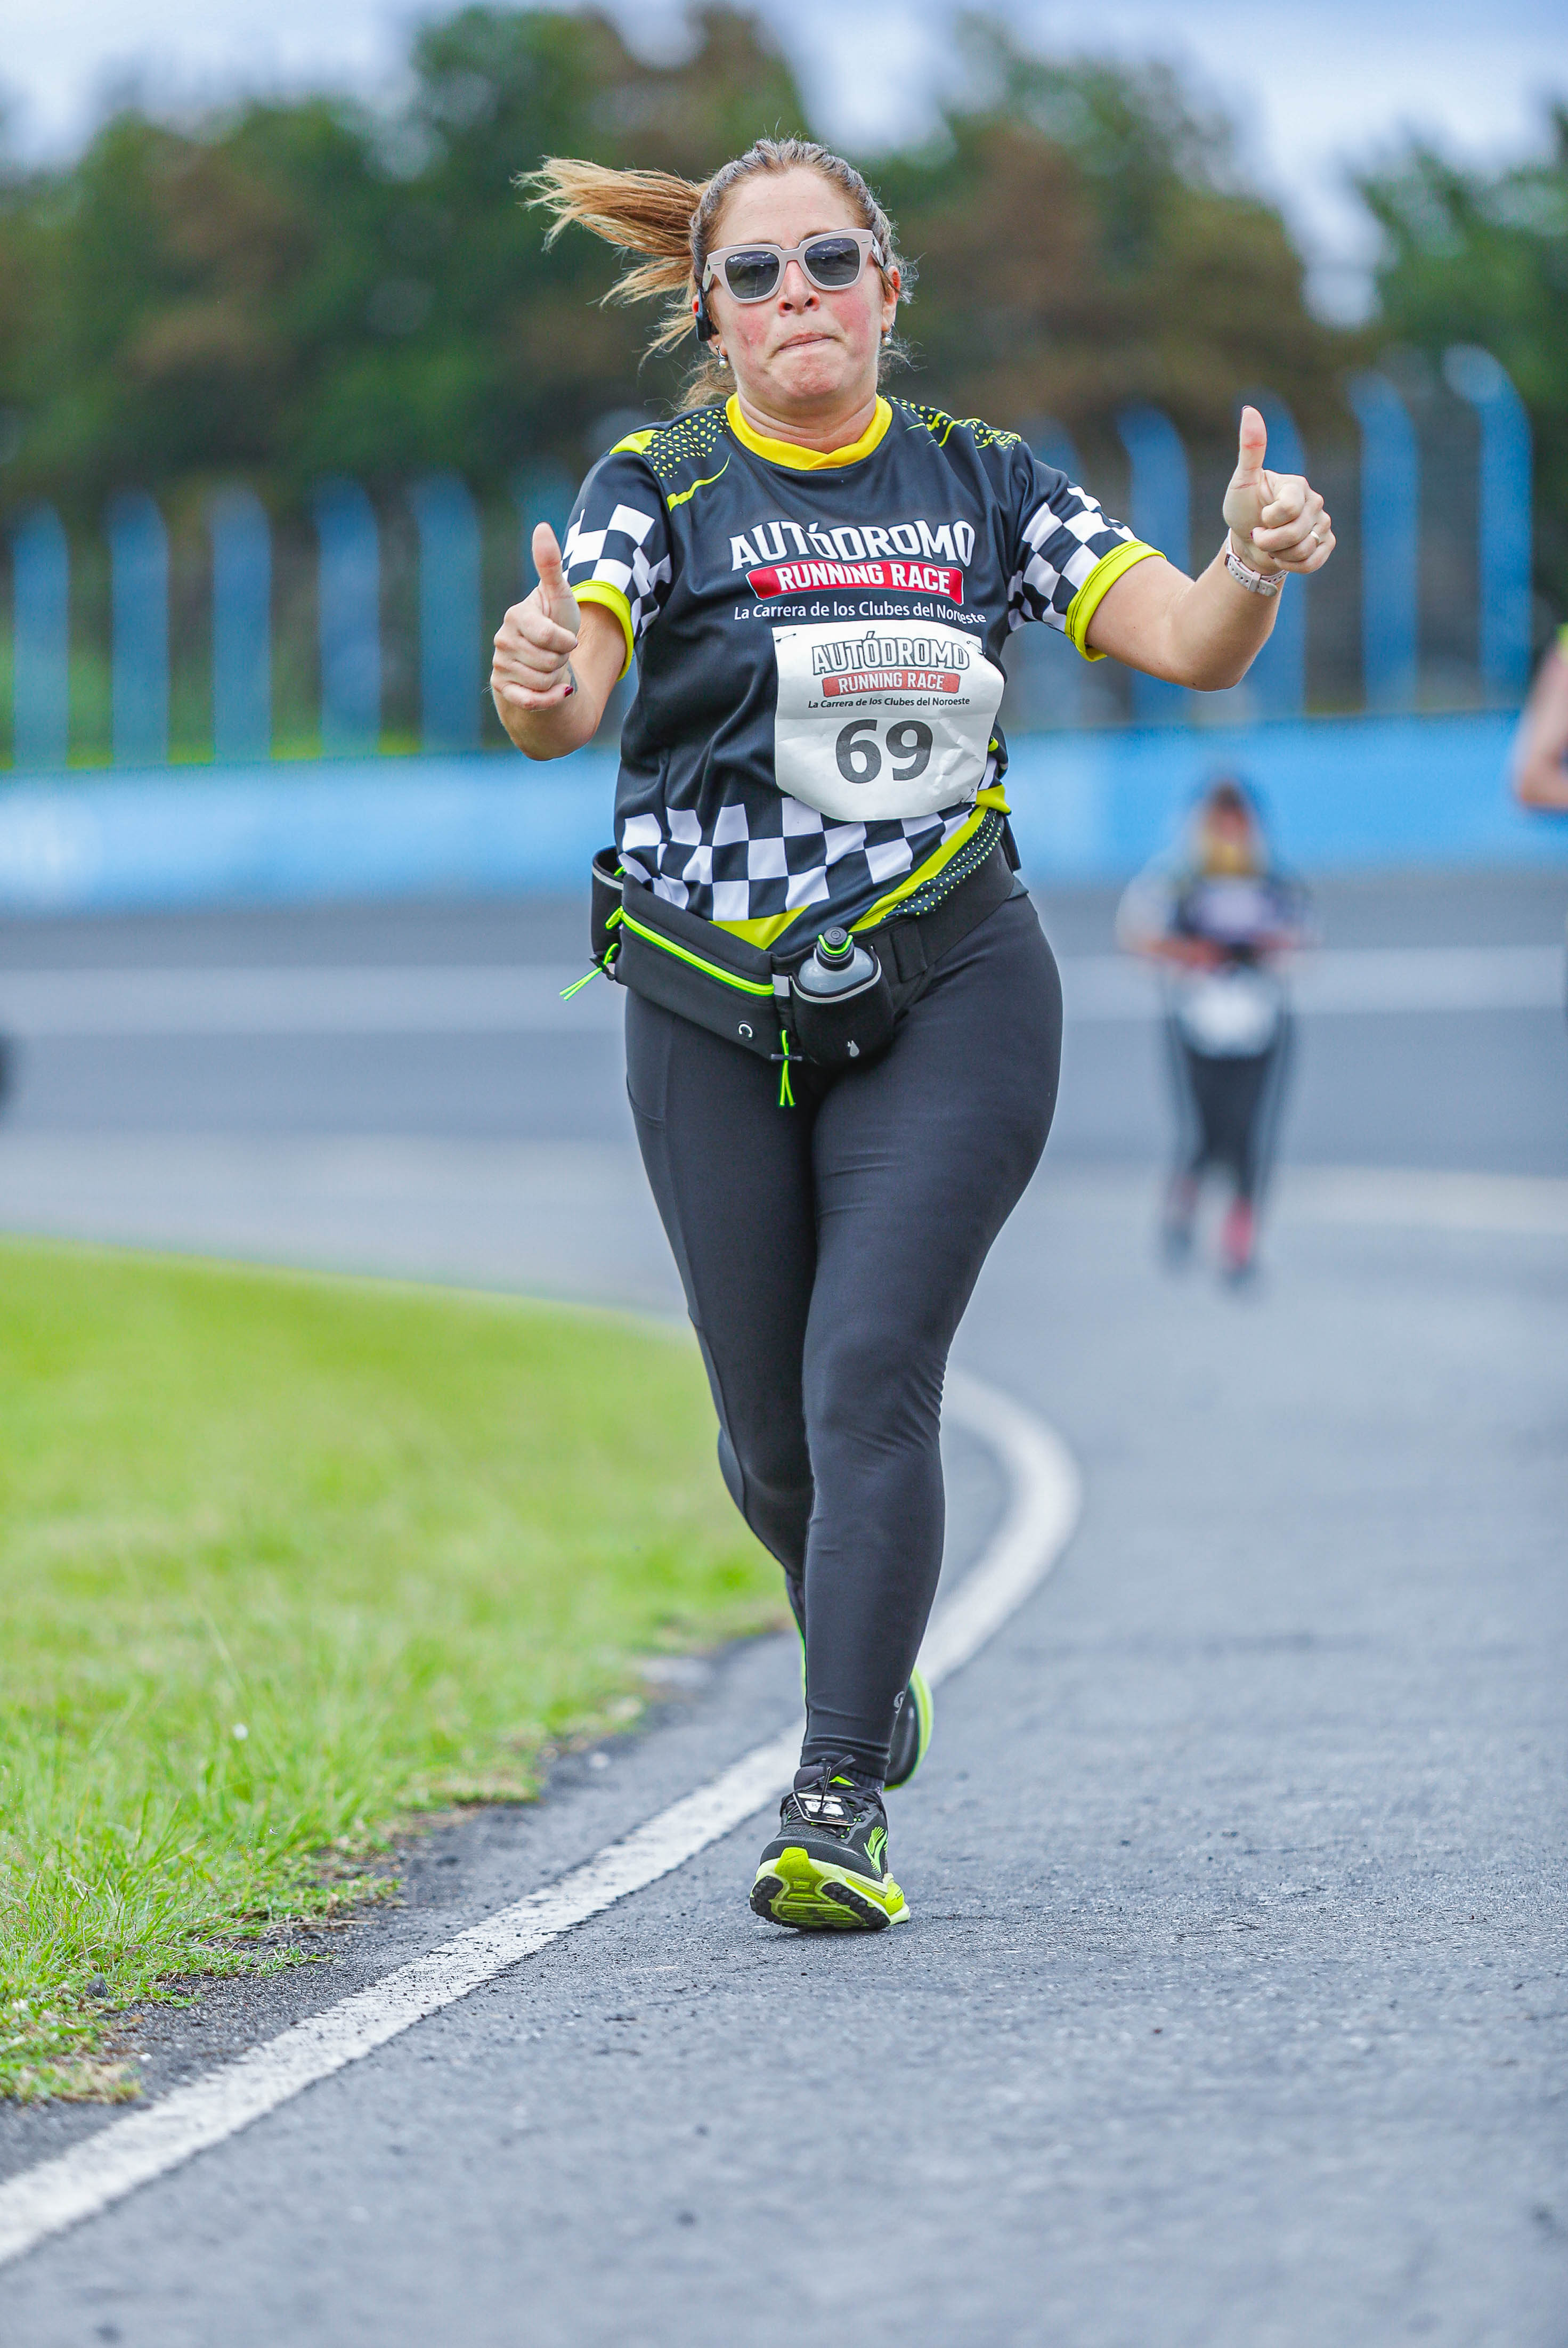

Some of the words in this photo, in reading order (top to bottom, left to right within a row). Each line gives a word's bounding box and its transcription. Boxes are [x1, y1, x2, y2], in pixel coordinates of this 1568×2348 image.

[775, 563, 884, 591] RUNNING
[890, 563, 950, 595] RACE
[734, 607, 749, 620] La
[753, 604, 806, 617] Carrera
[810, 601, 830, 616] de
[834, 601, 856, 616] los
[859, 600, 910, 616] Clubes
[913, 602, 933, 618] del
[811, 631, 970, 676] AUTÓDROMO
[838, 672, 903, 694] RUNNING
[907, 672, 945, 690] RACE
[820, 700, 854, 708] Carrera
[884, 697, 914, 706] Clubes
[916, 697, 930, 706] del
[932, 697, 970, 706] Noroeste
[835, 719, 933, 784] 69
